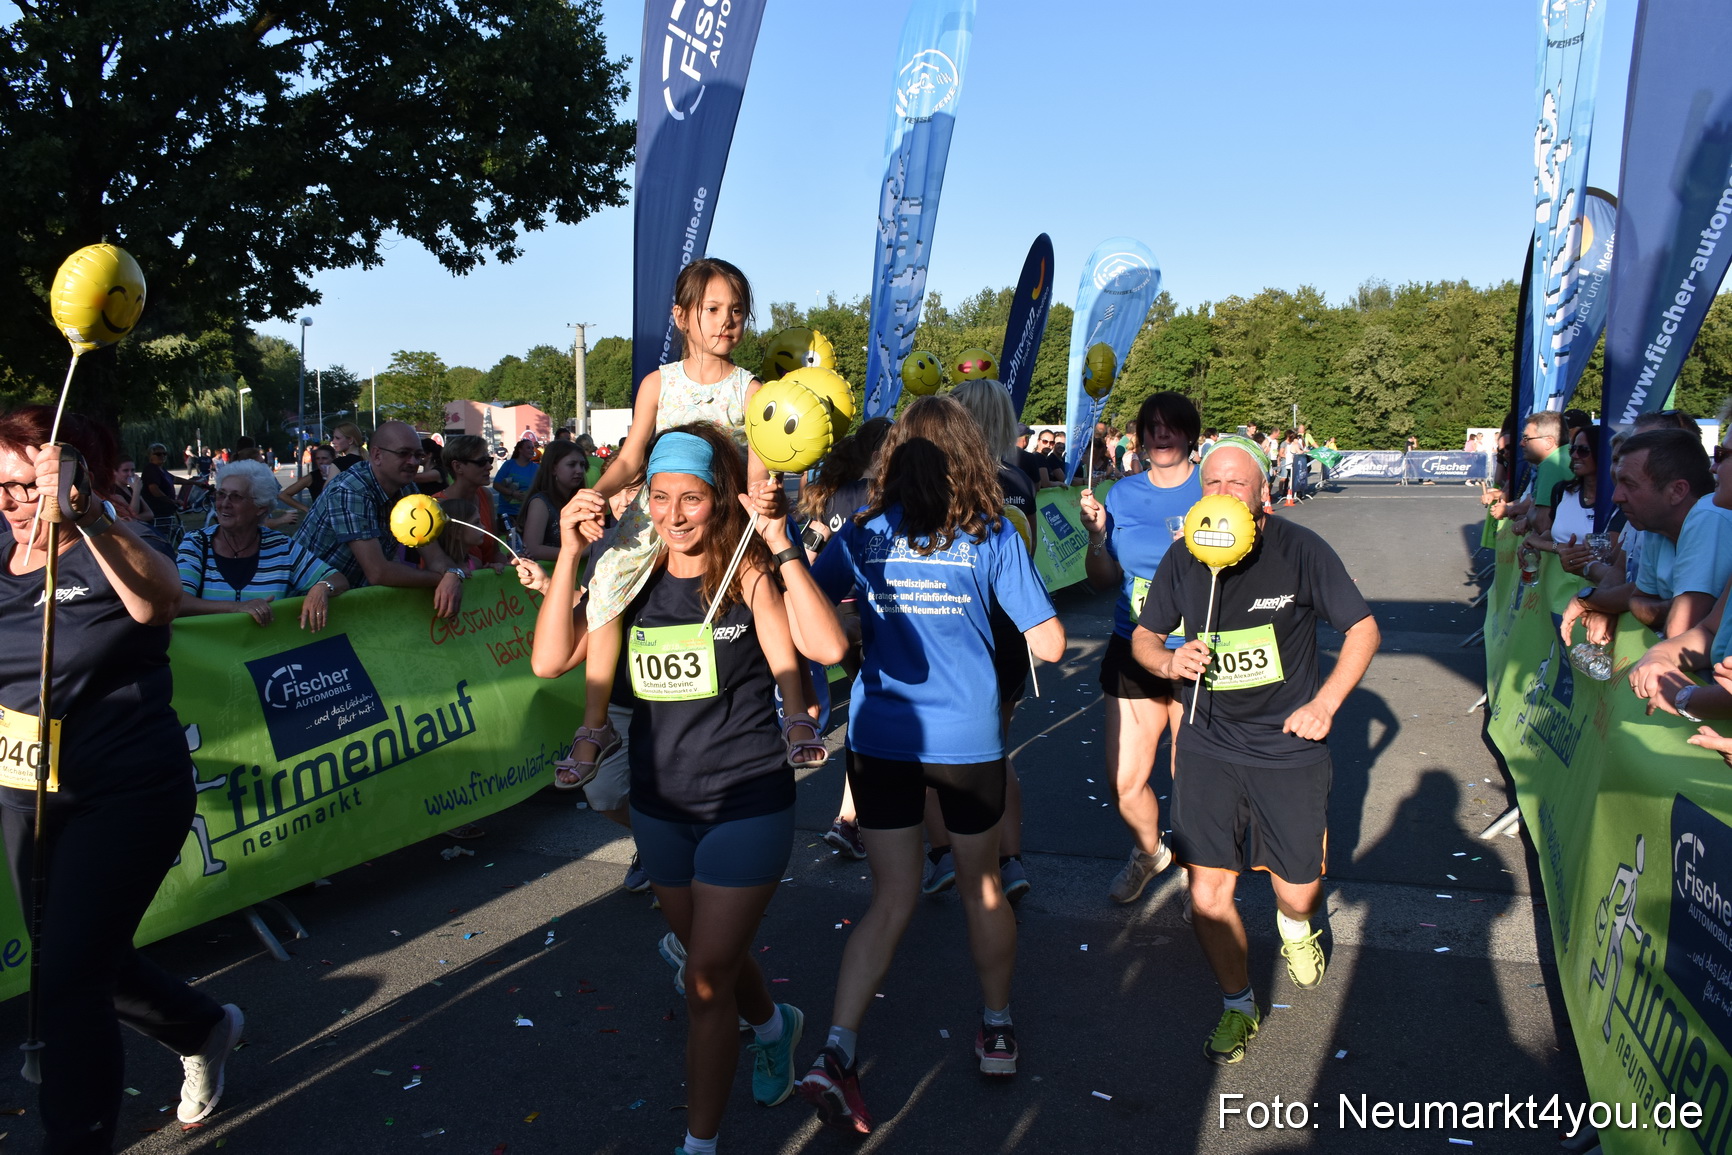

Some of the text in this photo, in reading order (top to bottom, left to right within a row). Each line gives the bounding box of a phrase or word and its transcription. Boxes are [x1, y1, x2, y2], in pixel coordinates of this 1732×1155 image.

[680, 0, 718, 82] Fis
[1586, 272, 1605, 299] und
[1431, 460, 1472, 471] Fischer
[868, 591, 899, 602] Beratngs-
[900, 592, 914, 601] und
[886, 578, 947, 590] Interdisziplinäre
[876, 604, 912, 614] Lebnshilfe
[913, 605, 950, 615] Neumarkt
[635, 652, 702, 680] 1063
[282, 667, 350, 702] Fischer
[295, 682, 353, 710] AUTOMOBILE
[642, 680, 667, 689] Schmid
[314, 710, 331, 726] und
[227, 679, 477, 832] firmenlauf
[243, 787, 362, 856] neumarkt
